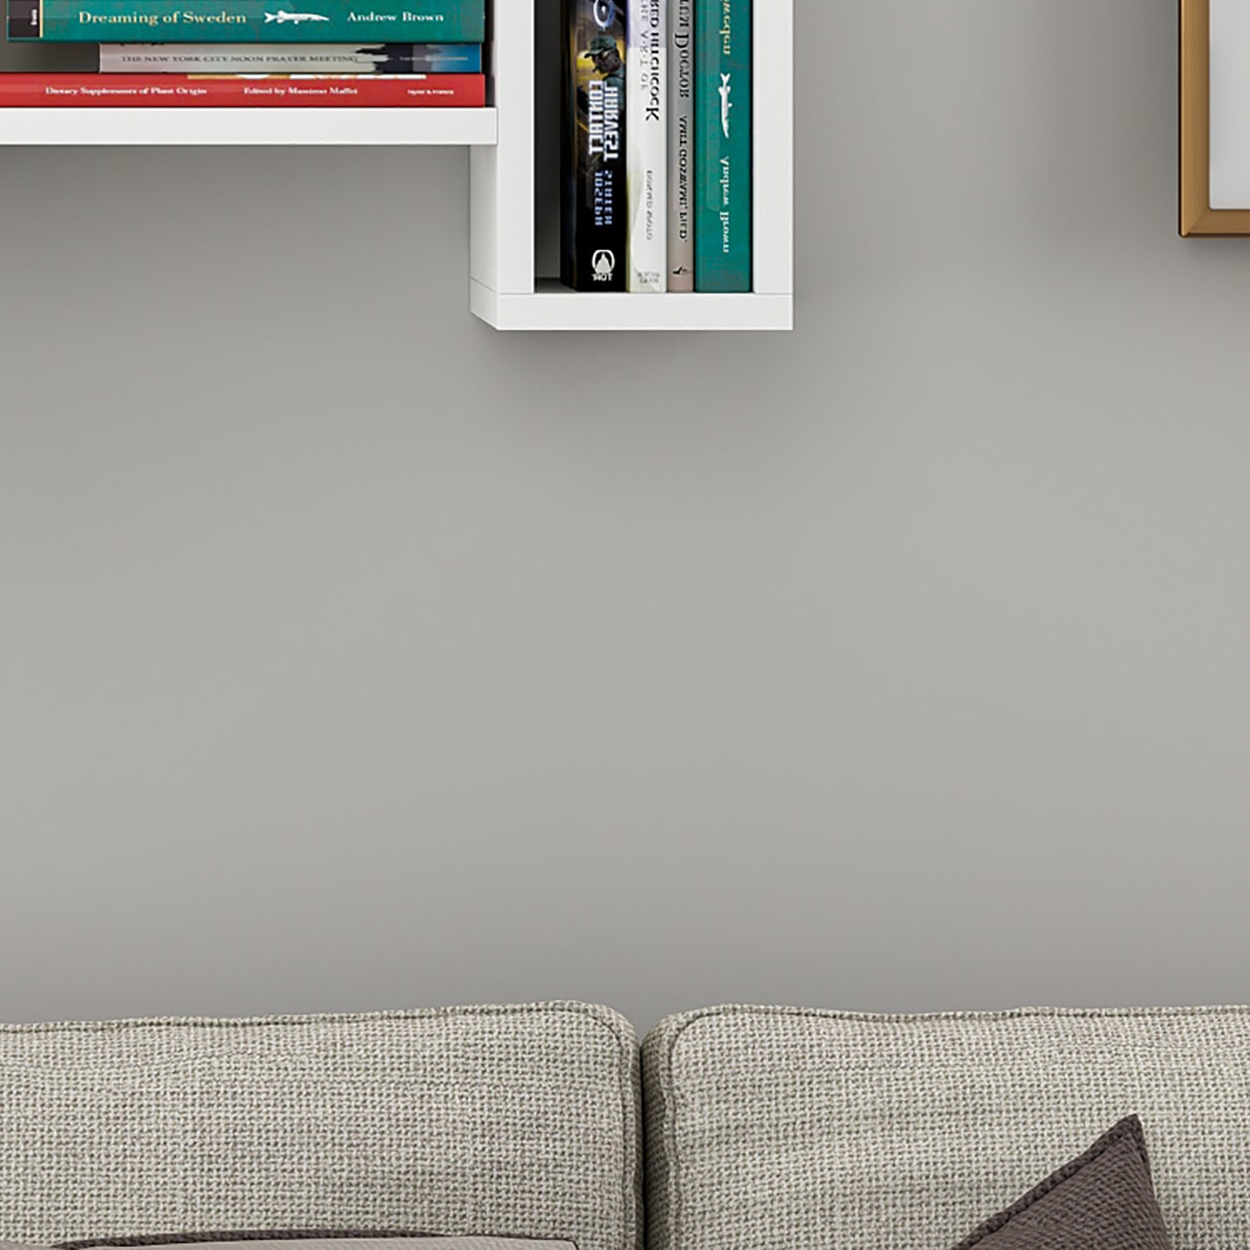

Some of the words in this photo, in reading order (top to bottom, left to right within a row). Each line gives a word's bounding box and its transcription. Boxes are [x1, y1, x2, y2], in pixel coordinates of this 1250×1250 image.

[79, 11, 158, 26] Dreaming
[163, 11, 181, 23] of
[182, 11, 247, 24] Sweden
[347, 11, 397, 22] Andrew
[403, 12, 444, 22] Brown
[46, 87, 78, 95] Dietary
[81, 87, 137, 95] Supplements
[139, 87, 149, 95] of
[151, 87, 174, 95] Plant
[176, 87, 207, 95] Origin
[244, 87, 273, 95] Edited
[274, 87, 285, 95] by
